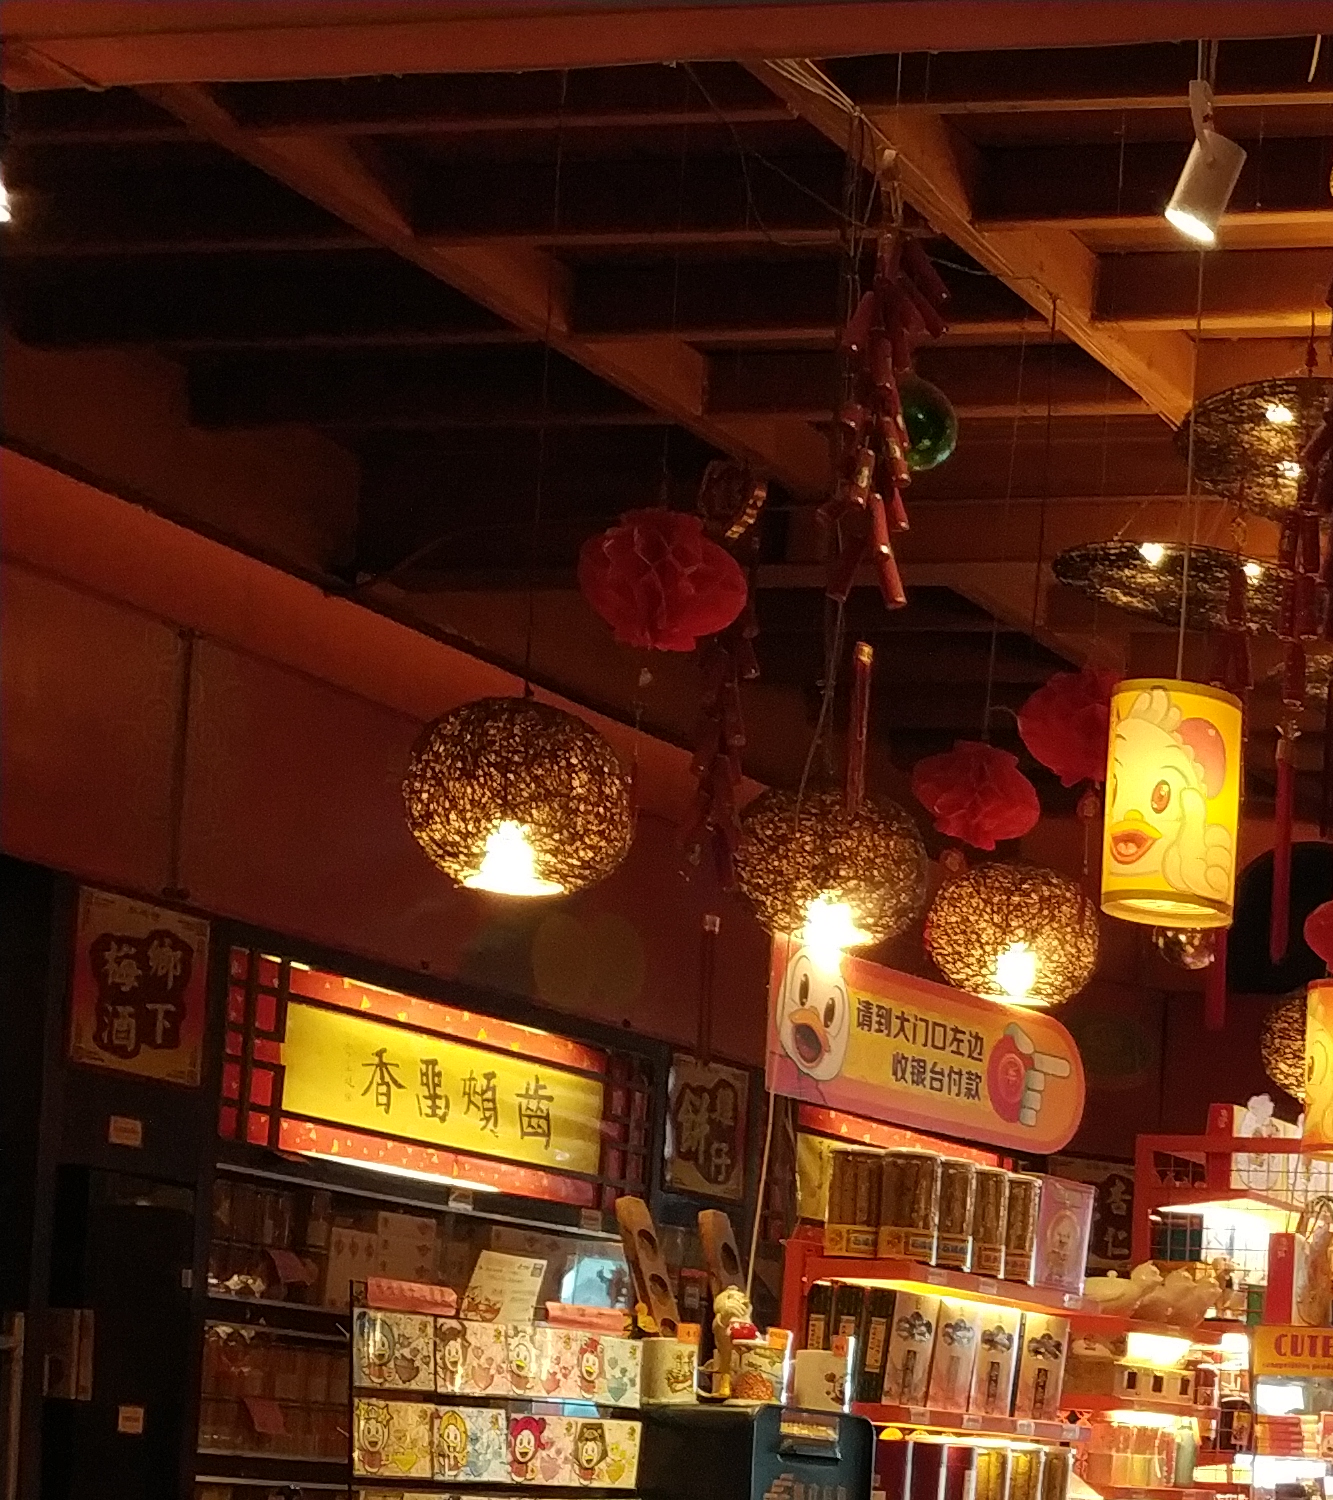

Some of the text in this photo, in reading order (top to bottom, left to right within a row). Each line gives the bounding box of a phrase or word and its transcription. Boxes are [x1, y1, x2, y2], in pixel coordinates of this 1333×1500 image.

[856, 997, 985, 1063] 请到大门口左边
[891, 1053, 983, 1102] 收银台付款
[1274, 1333, 1333, 1358] CUTE
